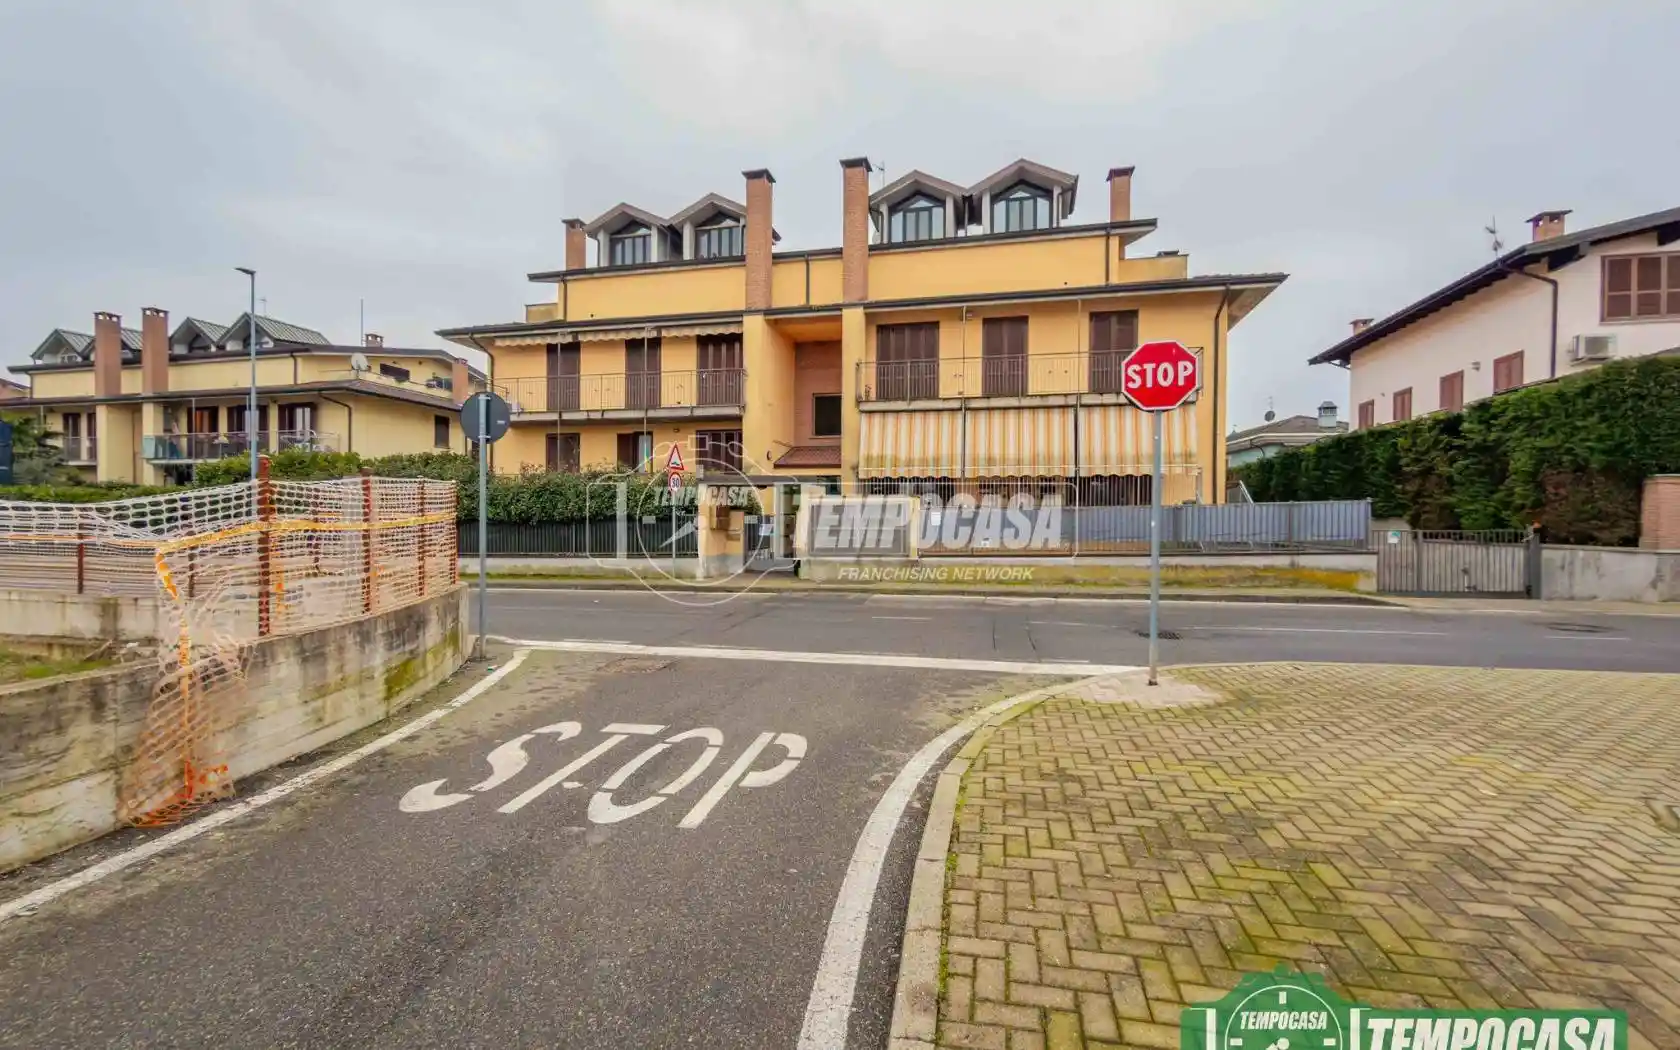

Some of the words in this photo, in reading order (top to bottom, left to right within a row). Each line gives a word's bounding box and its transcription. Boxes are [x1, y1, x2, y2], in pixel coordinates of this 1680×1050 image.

[1126, 360, 1194, 389] STOP
[671, 477, 680, 488] 30
[399, 721, 807, 828] STOP
